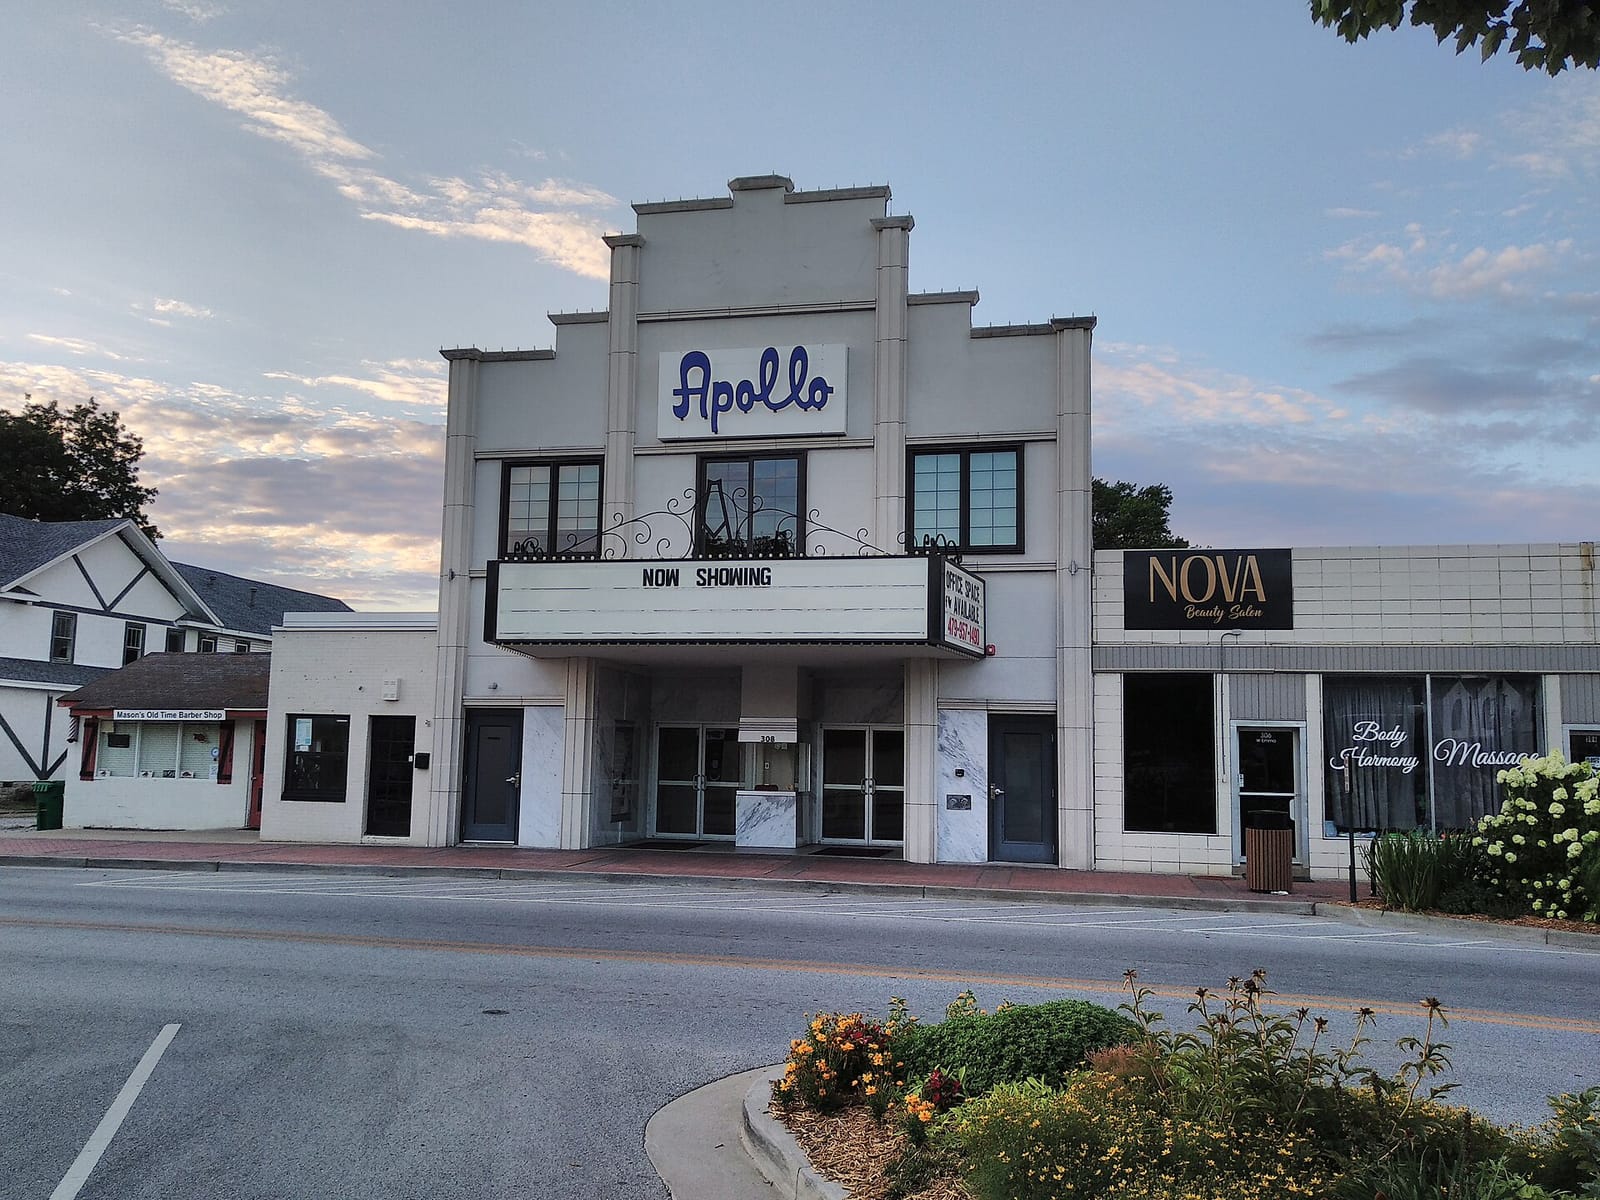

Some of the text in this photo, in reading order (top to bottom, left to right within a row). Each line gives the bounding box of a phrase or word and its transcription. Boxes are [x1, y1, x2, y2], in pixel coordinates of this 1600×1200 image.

[672, 345, 834, 434] Apollo
[642, 567, 772, 586] NOW SHOWING
[946, 570, 963, 595] OFFICE
[965, 580, 980, 604] SPACE
[1149, 555, 1267, 603] NOVA
[954, 596, 980, 624] AVAILABLE
[1184, 604, 1264, 624] Beauty Salon
[116, 711, 223, 720] Mason's Old Time Barber Shop
[760, 735, 776, 743] 308
[1352, 721, 1407, 748] Body
[1329, 746, 1419, 774] Harmony
